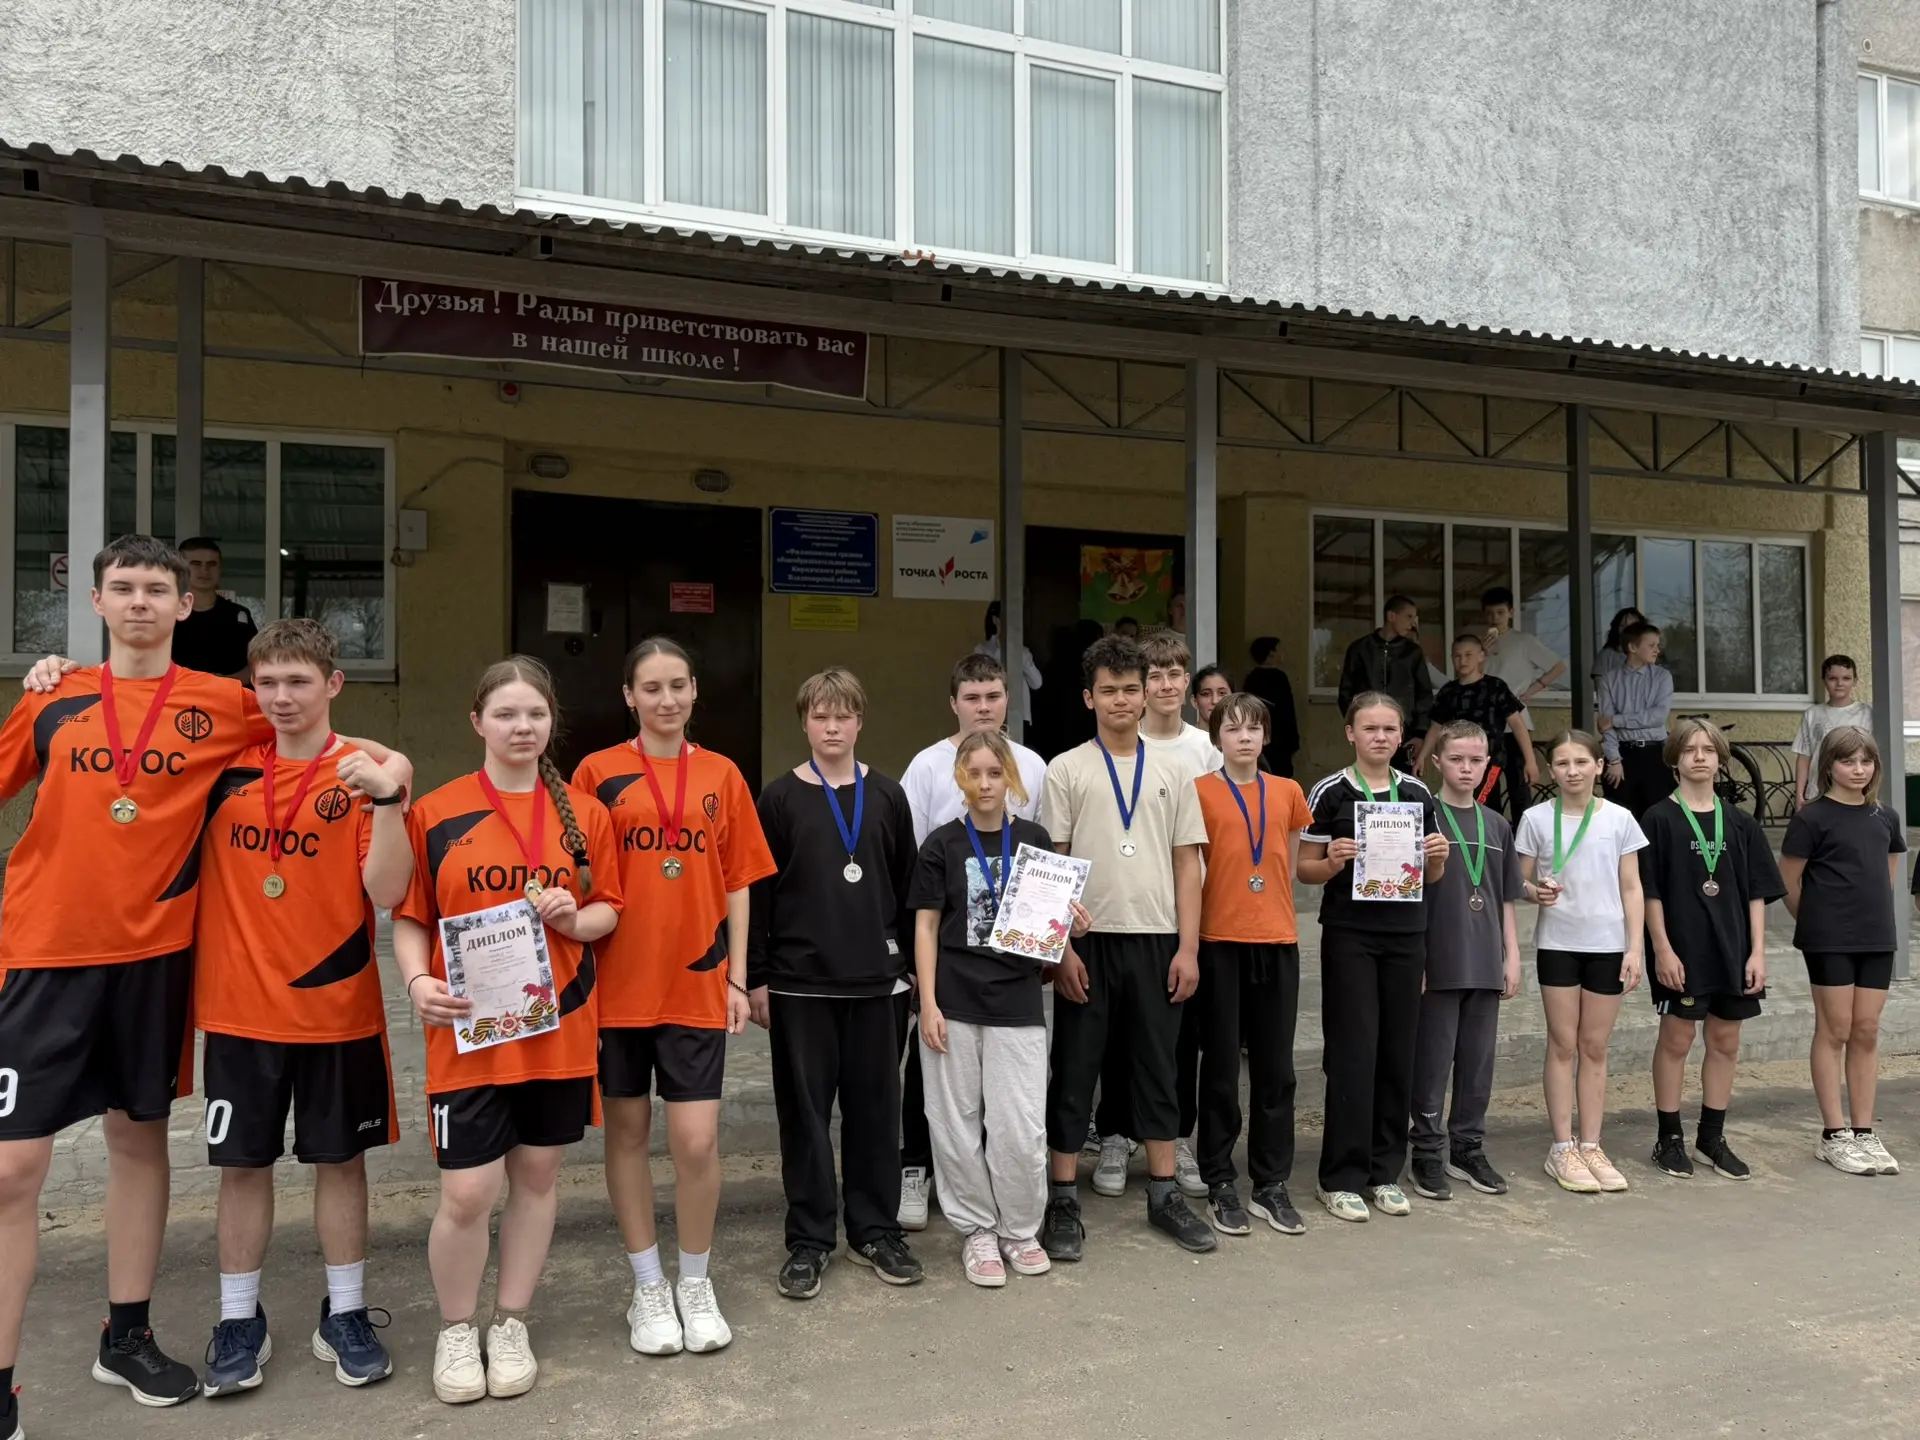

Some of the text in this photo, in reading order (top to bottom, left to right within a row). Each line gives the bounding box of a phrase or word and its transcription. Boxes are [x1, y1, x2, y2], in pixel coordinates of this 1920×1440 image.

[516, 293, 594, 324] Рады
[605, 310, 808, 347] приветствовать
[817, 336, 856, 356] вас
[512, 332, 528, 348] в
[540, 333, 629, 361] нашей
[899, 568, 988, 580] ТОЧКА РОСТА
[71, 747, 187, 776] КООС
[1368, 820, 1412, 830] ДИПЛОМ
[1026, 866, 1073, 885] ДИПЛОМ
[466, 925, 527, 952] ДИПЛОМ
[432, 1103, 449, 1149] 11
